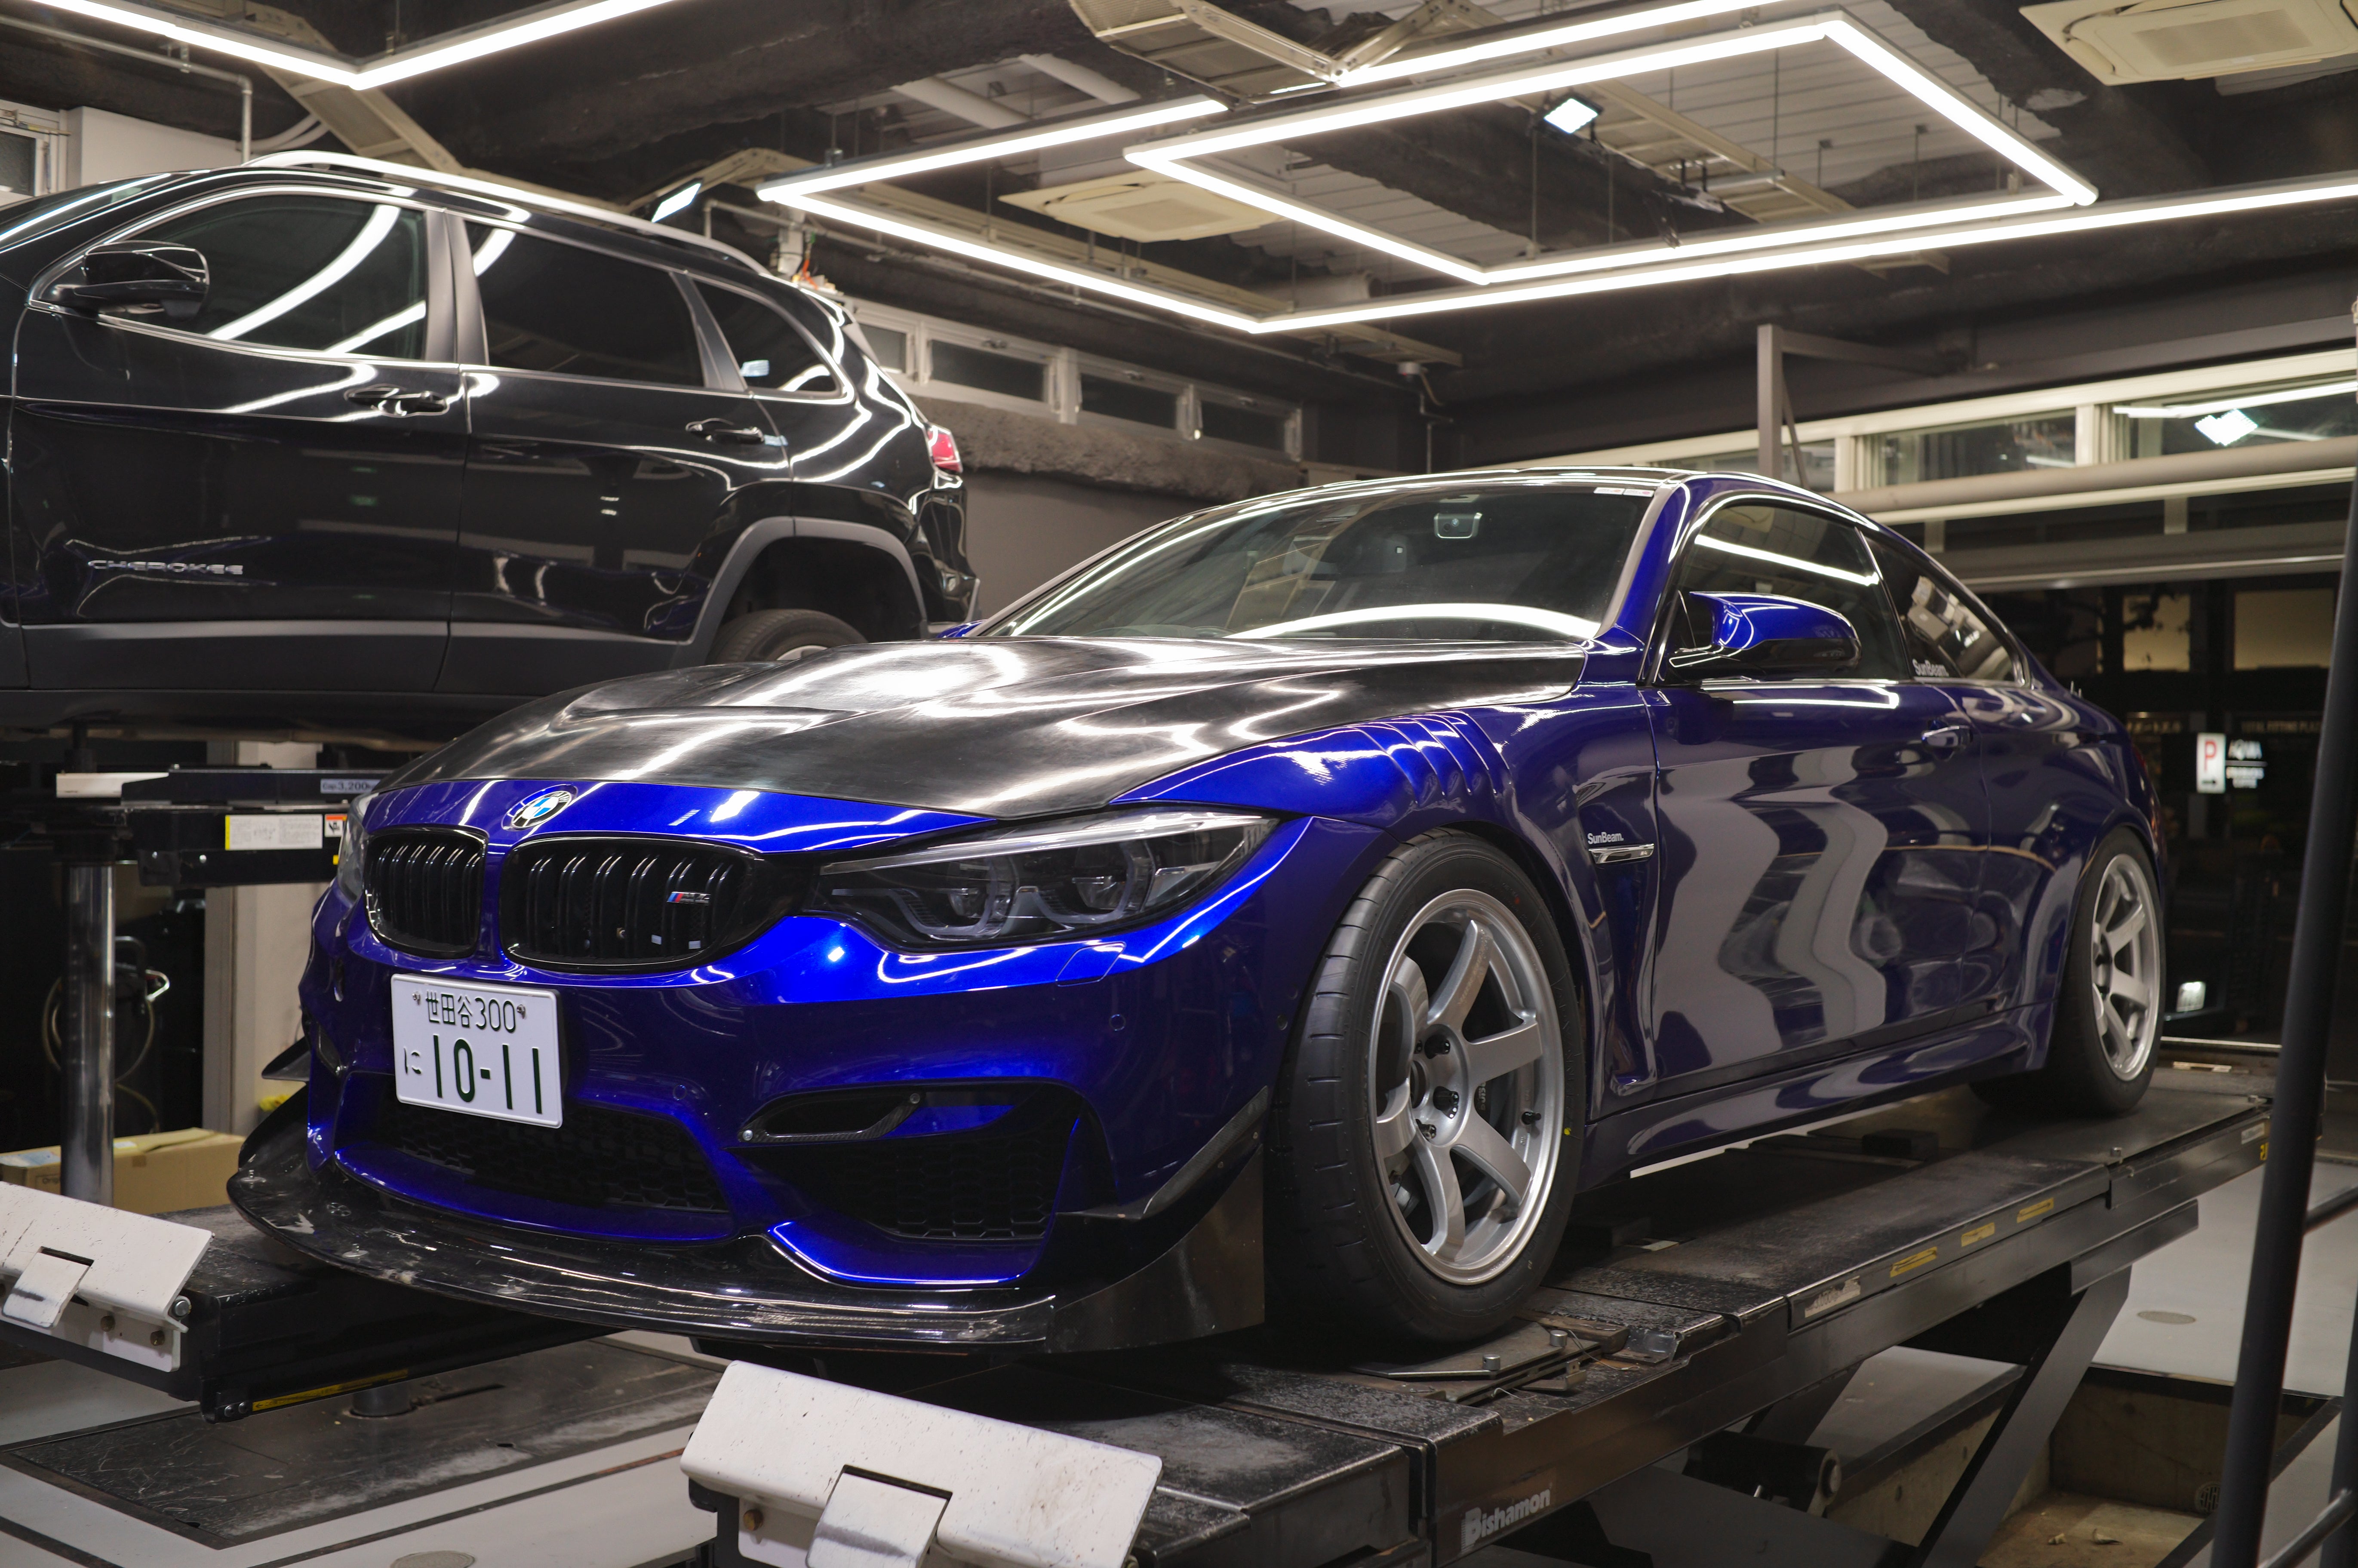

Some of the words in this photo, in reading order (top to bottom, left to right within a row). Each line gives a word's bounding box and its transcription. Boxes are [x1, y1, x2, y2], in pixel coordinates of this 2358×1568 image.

[88, 560, 243, 575] CHEROKEE
[404, 1047, 422, 1074] に
[433, 1033, 543, 1115] 10-11
[1461, 1488, 1550, 1552] Bishamon
